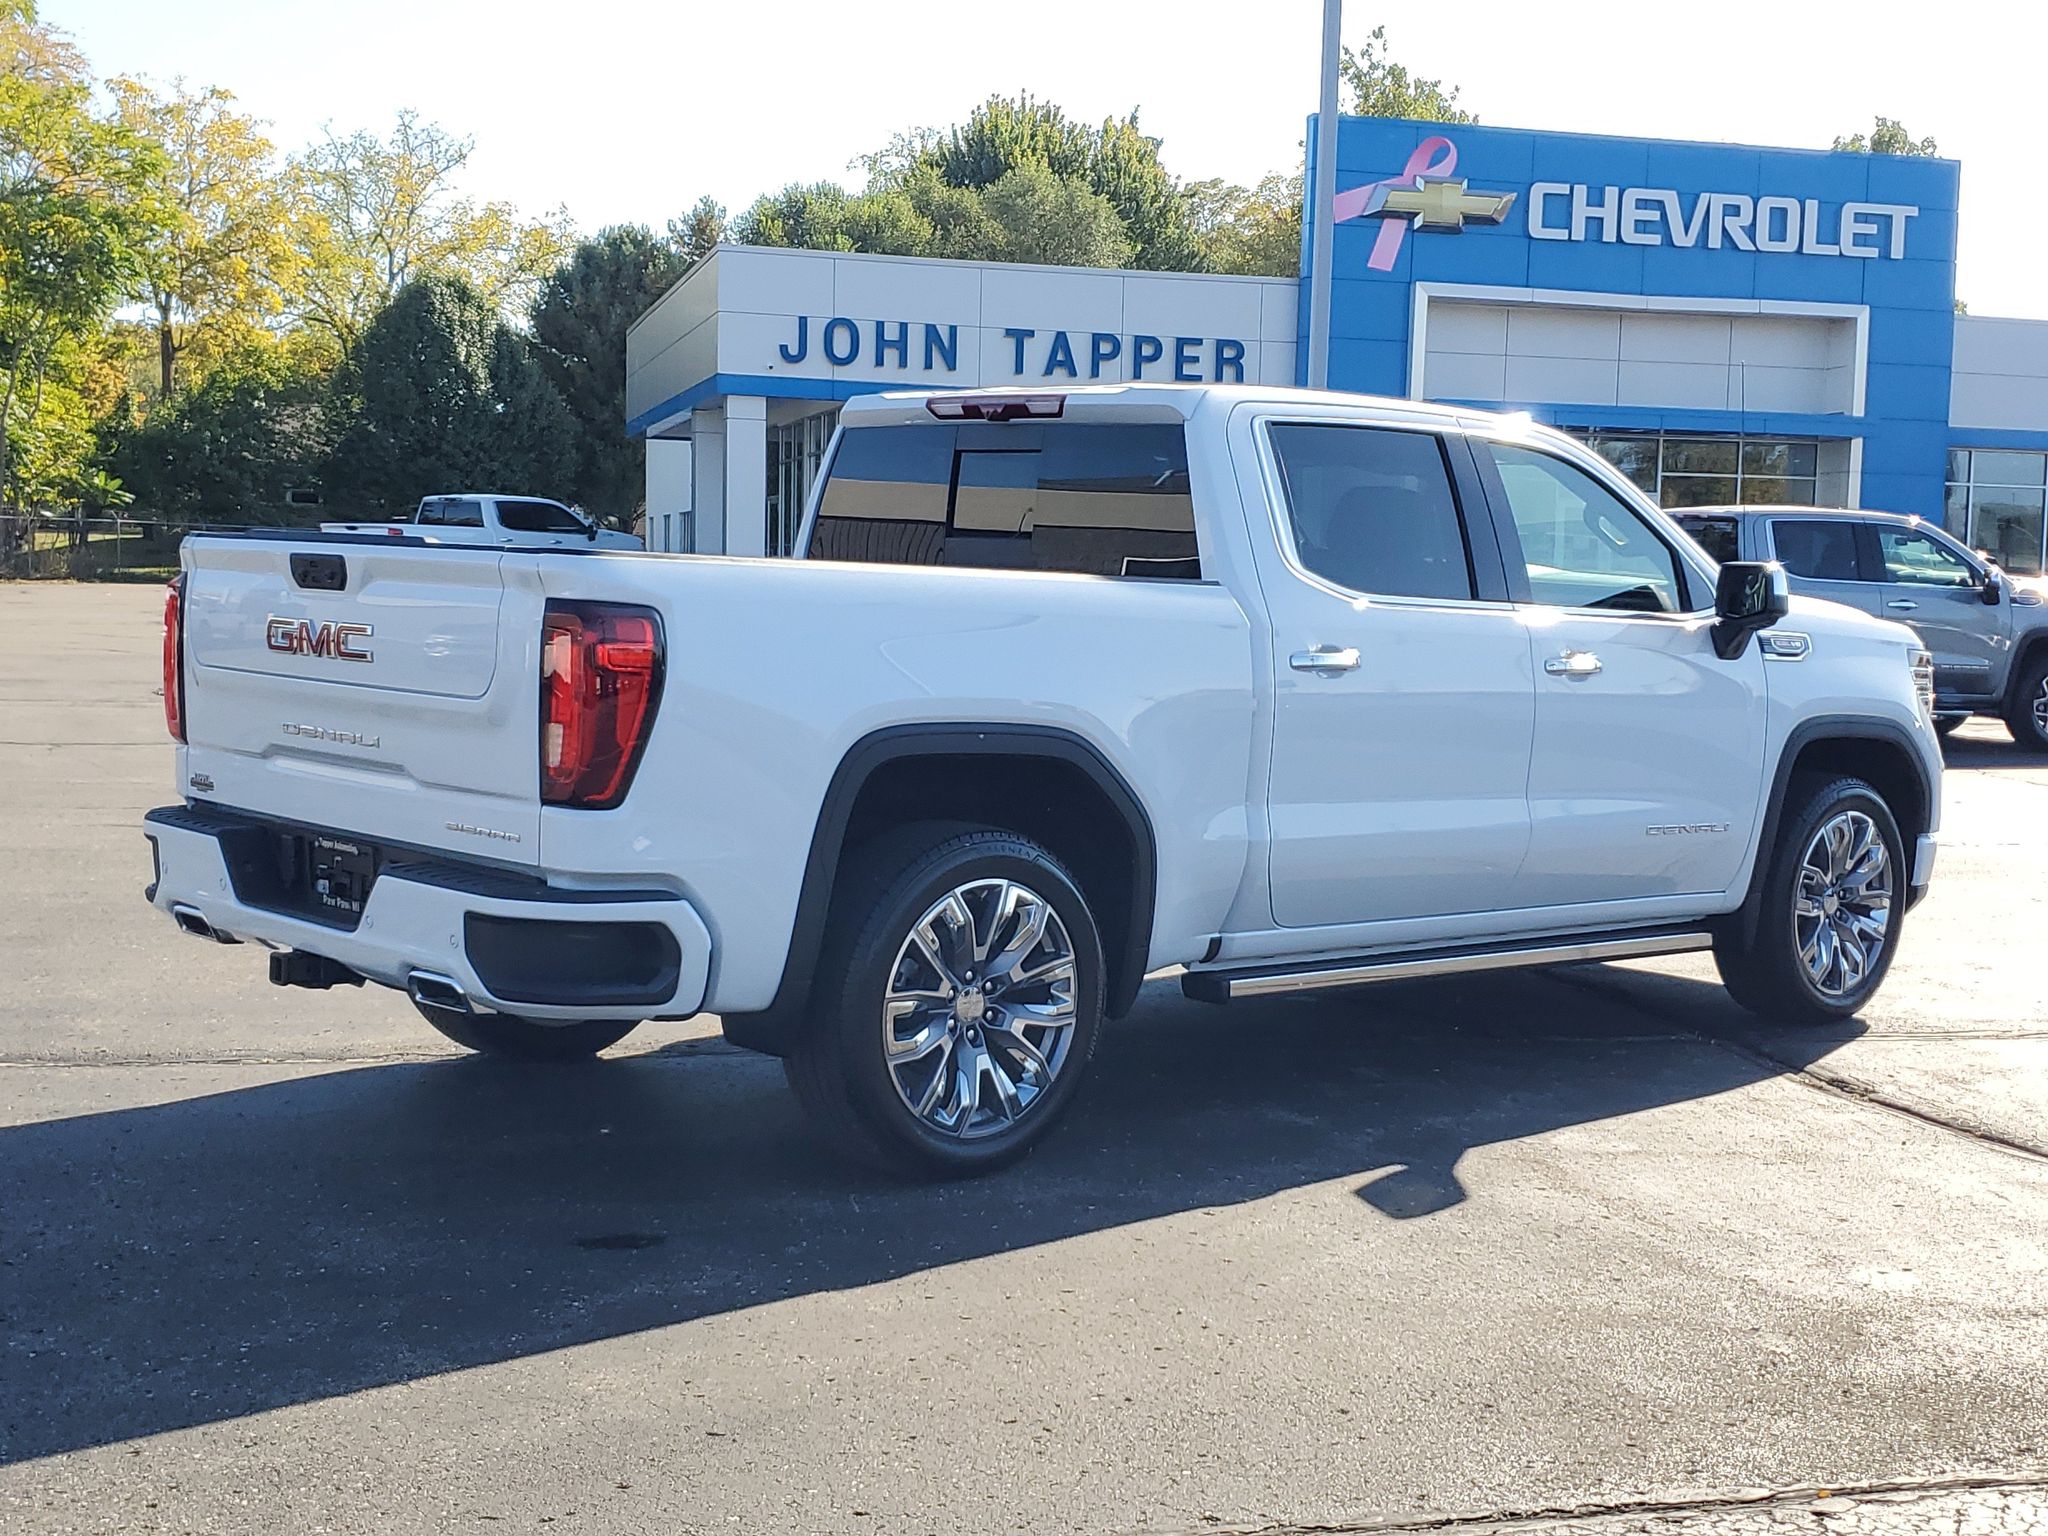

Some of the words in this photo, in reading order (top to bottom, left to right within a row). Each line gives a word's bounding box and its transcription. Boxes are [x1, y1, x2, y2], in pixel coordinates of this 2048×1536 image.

[1528, 181, 1919, 260] CHEVROLET
[779, 315, 958, 372] JOHN
[1004, 327, 1246, 384] TAPPER
[266, 614, 375, 663] GMC
[282, 722, 381, 749] DENALI
[446, 821, 521, 843] SIERRA
[1646, 822, 1731, 837] DENALI
